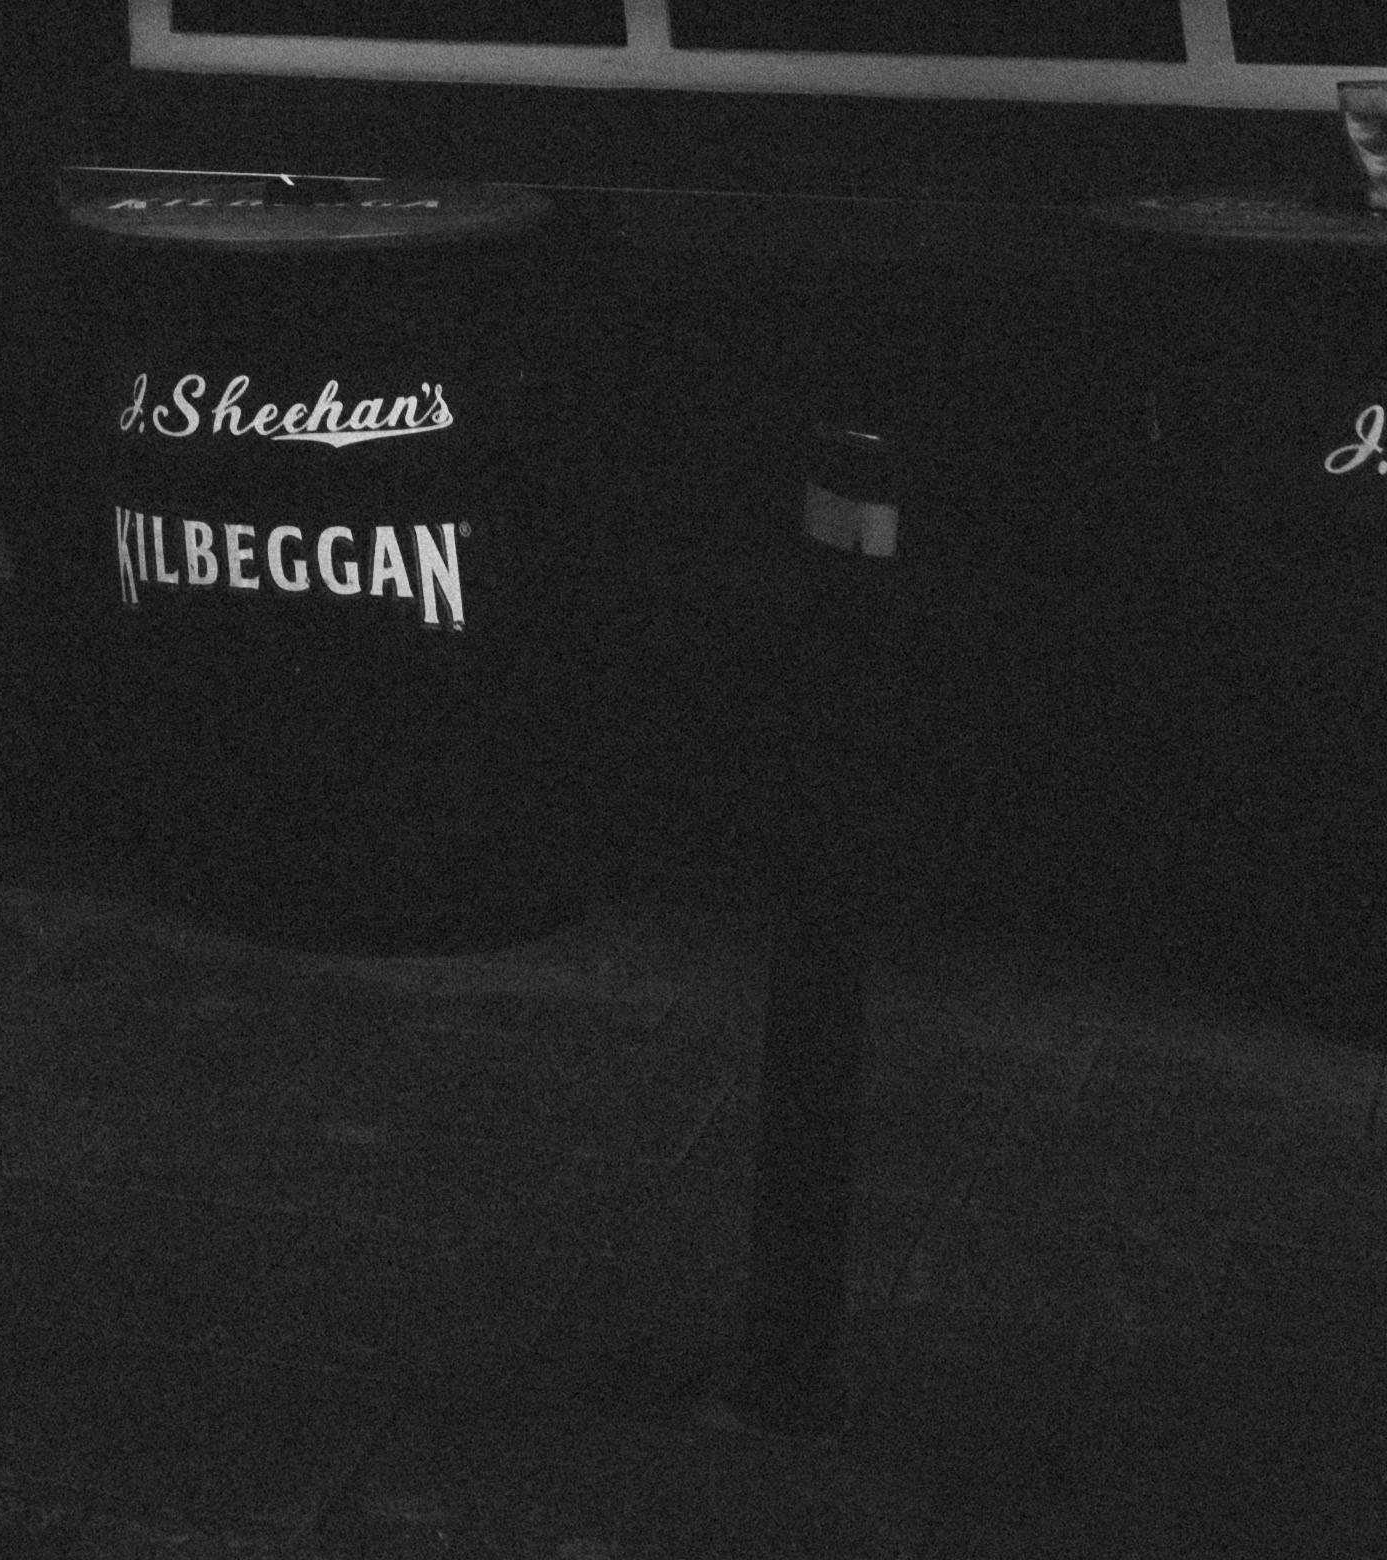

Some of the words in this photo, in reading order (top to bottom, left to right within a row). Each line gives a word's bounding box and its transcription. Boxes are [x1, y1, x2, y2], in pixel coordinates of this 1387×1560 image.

[120, 372, 148, 434] J.
[151, 372, 455, 448] Sheehan's
[115, 505, 467, 632] KILBEGGAN
